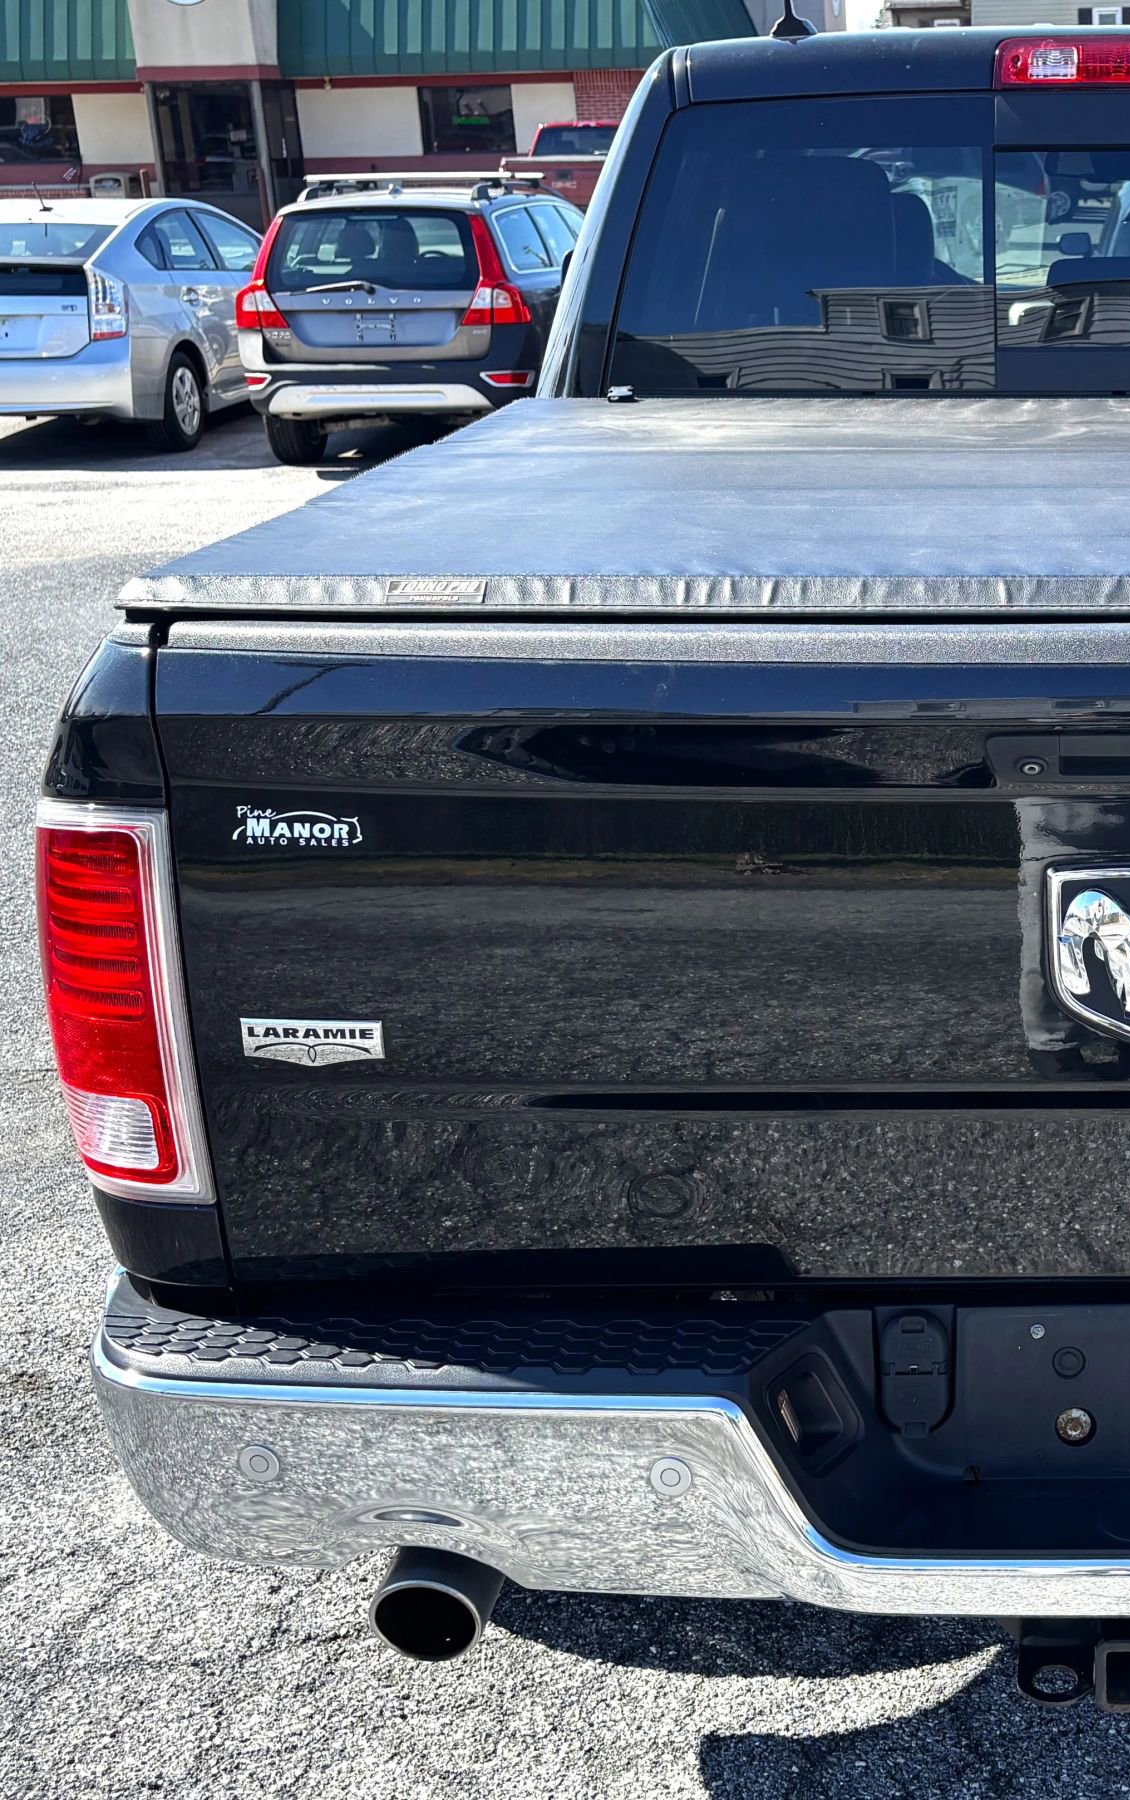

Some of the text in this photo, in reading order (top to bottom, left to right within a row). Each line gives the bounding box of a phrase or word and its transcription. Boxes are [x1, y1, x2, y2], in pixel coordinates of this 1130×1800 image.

[322, 297, 421, 305] VOLVO
[236, 805, 276, 819] Pine
[246, 818, 350, 839] MANOR
[246, 837, 349, 847] AUTO SALES
[247, 1026, 374, 1040] LARAMIE
